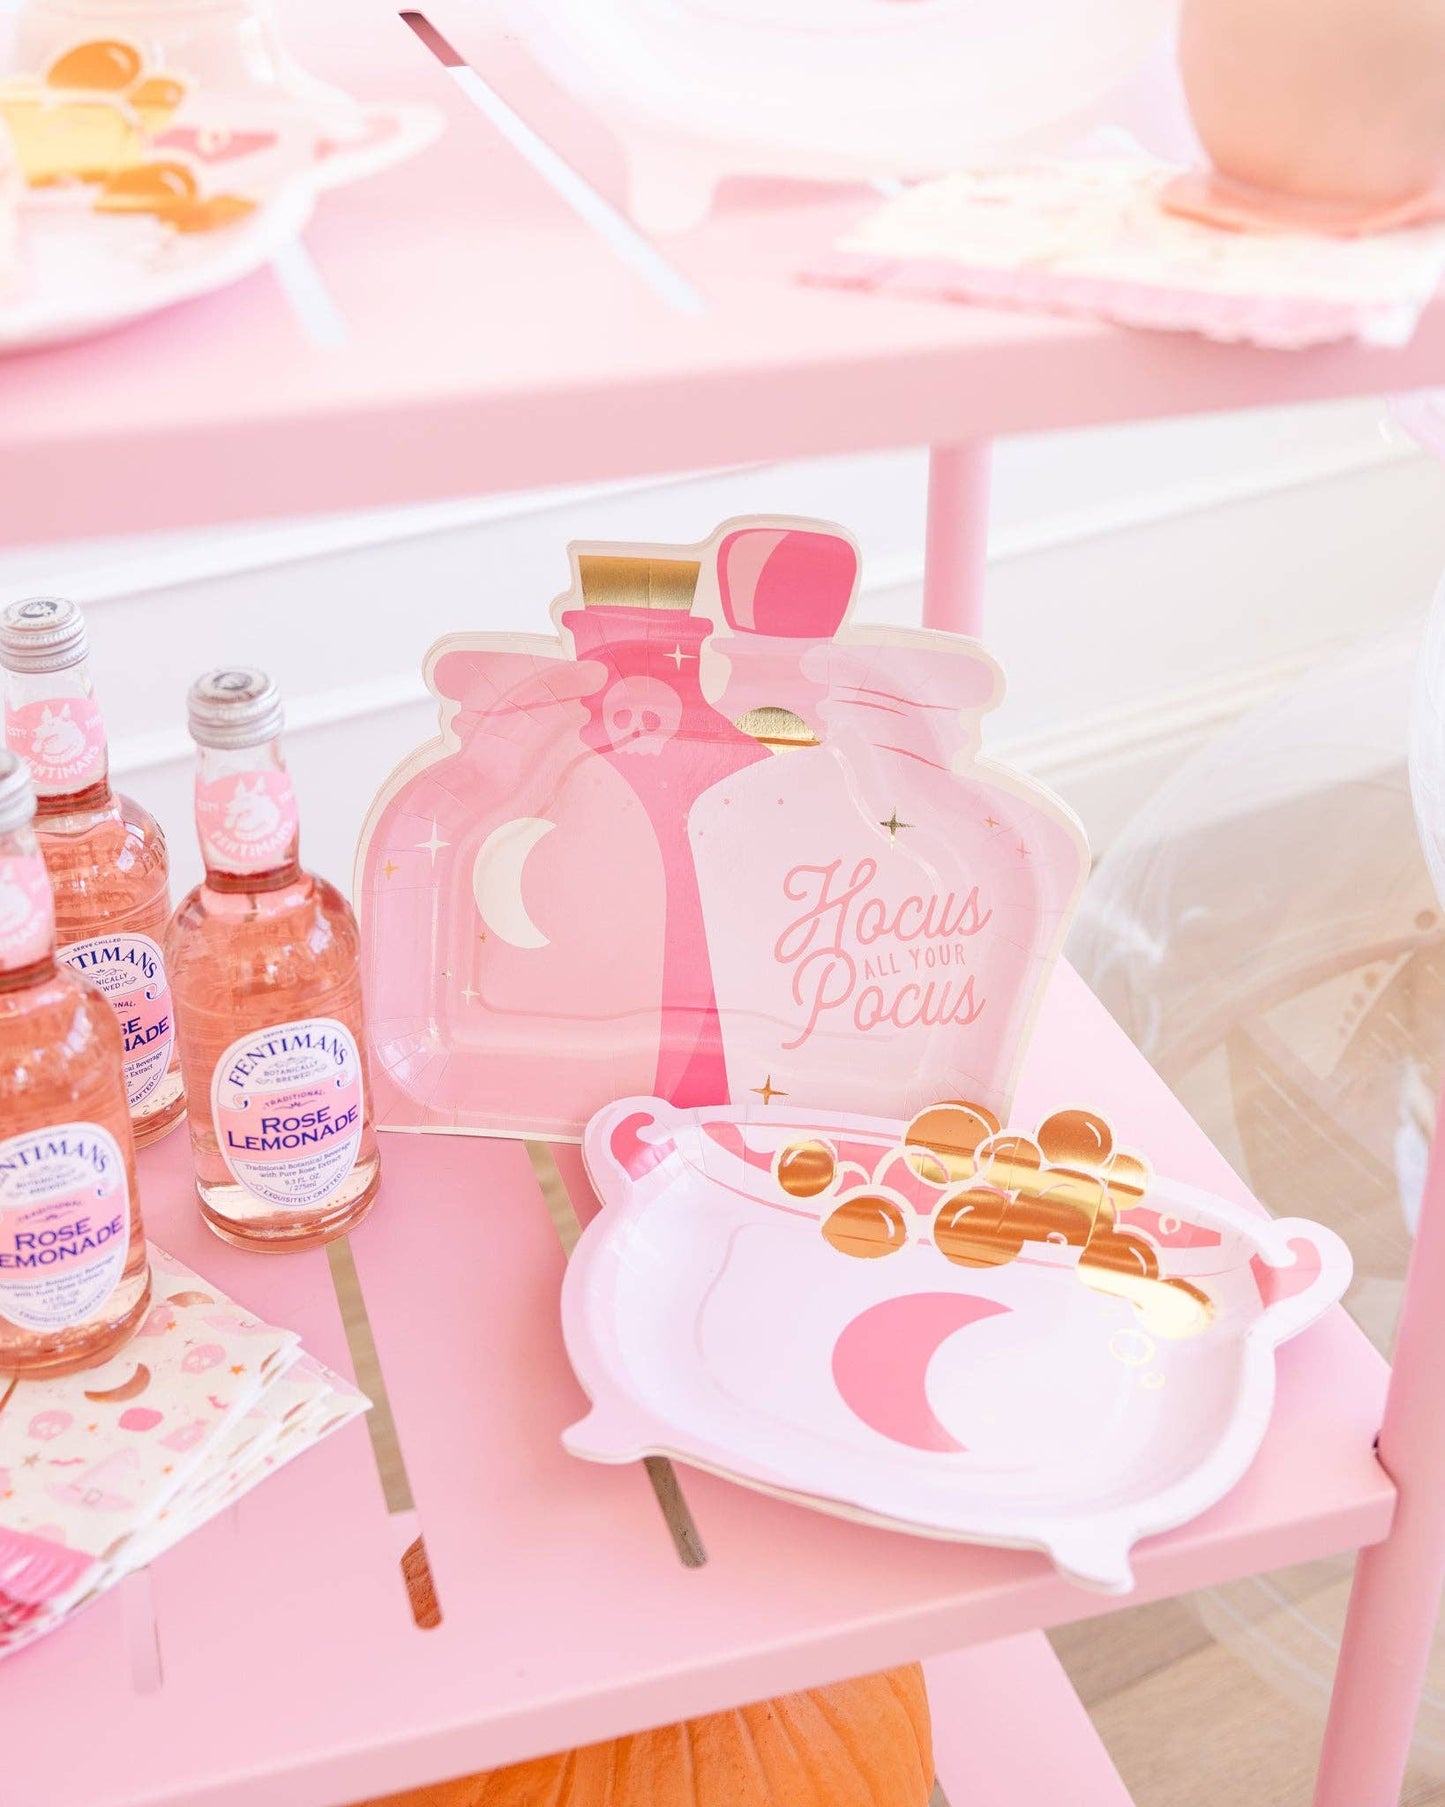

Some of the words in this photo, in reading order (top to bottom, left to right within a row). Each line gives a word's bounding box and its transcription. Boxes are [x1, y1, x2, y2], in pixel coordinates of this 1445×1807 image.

[774, 857, 993, 964] Hocus
[864, 953, 901, 980] ALL
[908, 944, 966, 970] YOUR
[781, 947, 987, 1051] Pocus
[228, 1033, 349, 1088] FENTIMANS
[227, 1103, 359, 1152] LEMONADE
[260, 1105, 332, 1135] ROSE
[14, 1216, 92, 1251] ROSE
